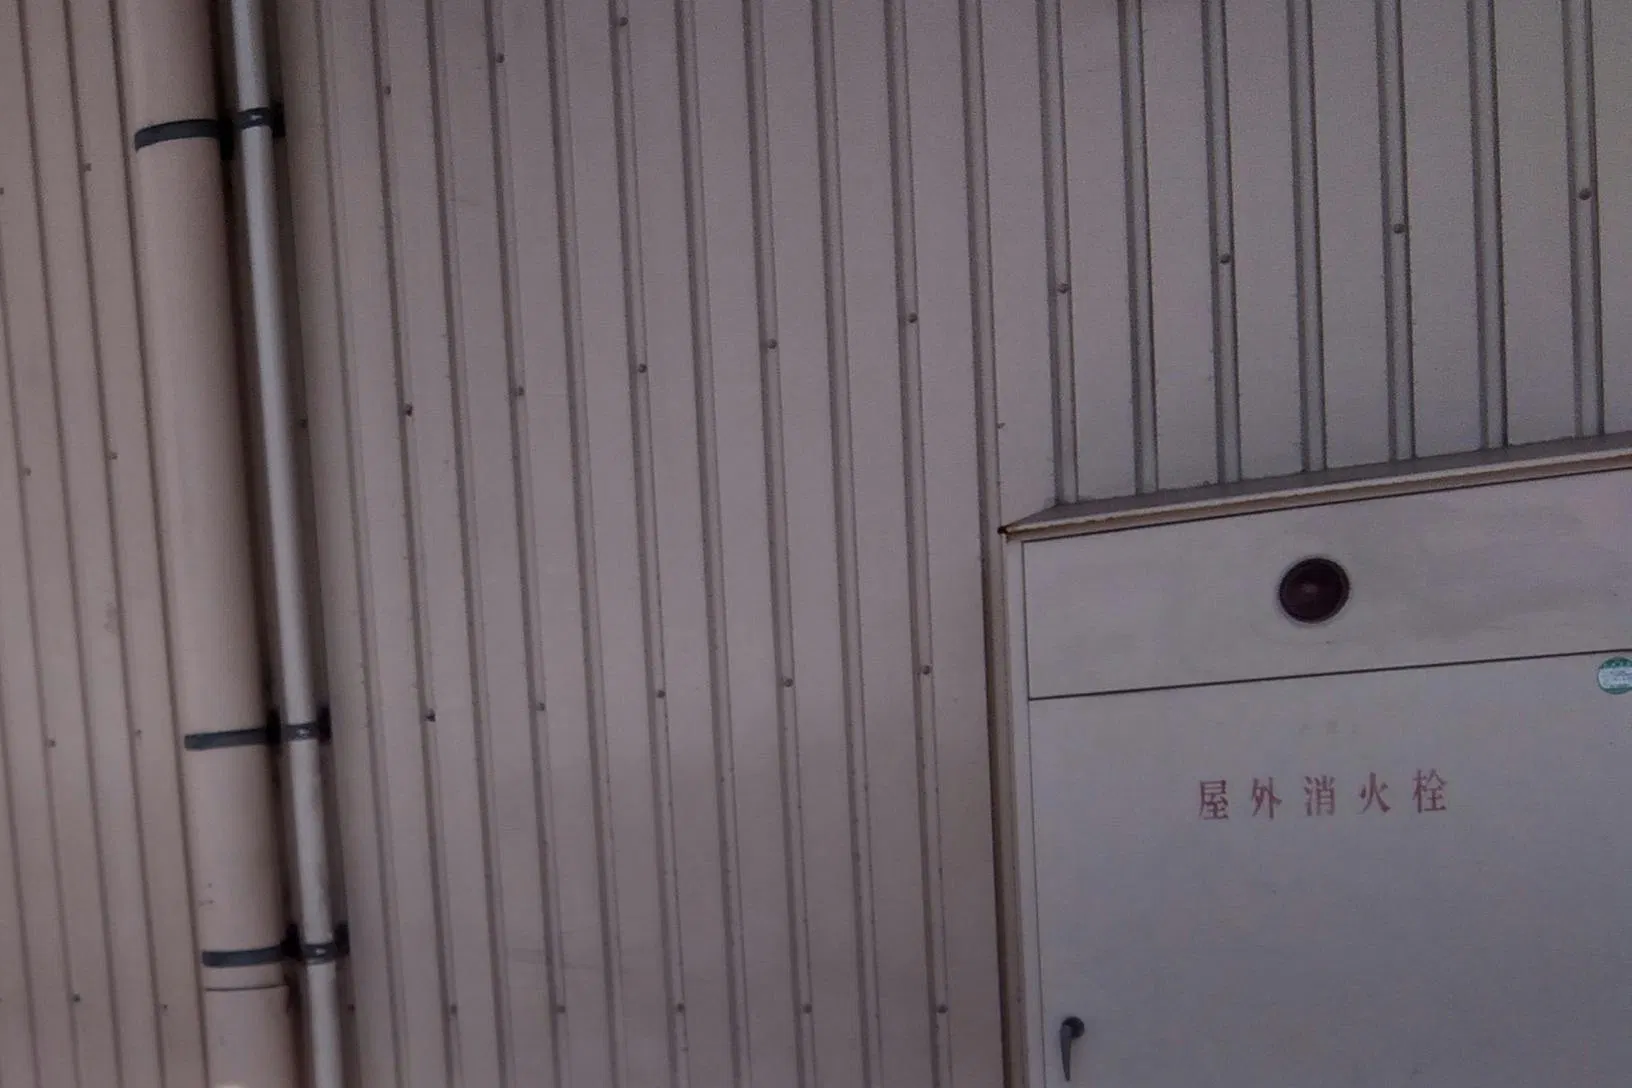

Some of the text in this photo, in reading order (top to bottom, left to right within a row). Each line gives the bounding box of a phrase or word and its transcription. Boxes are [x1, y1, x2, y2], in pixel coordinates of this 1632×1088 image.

[1198, 768, 1448, 820] 屋外消火栓
